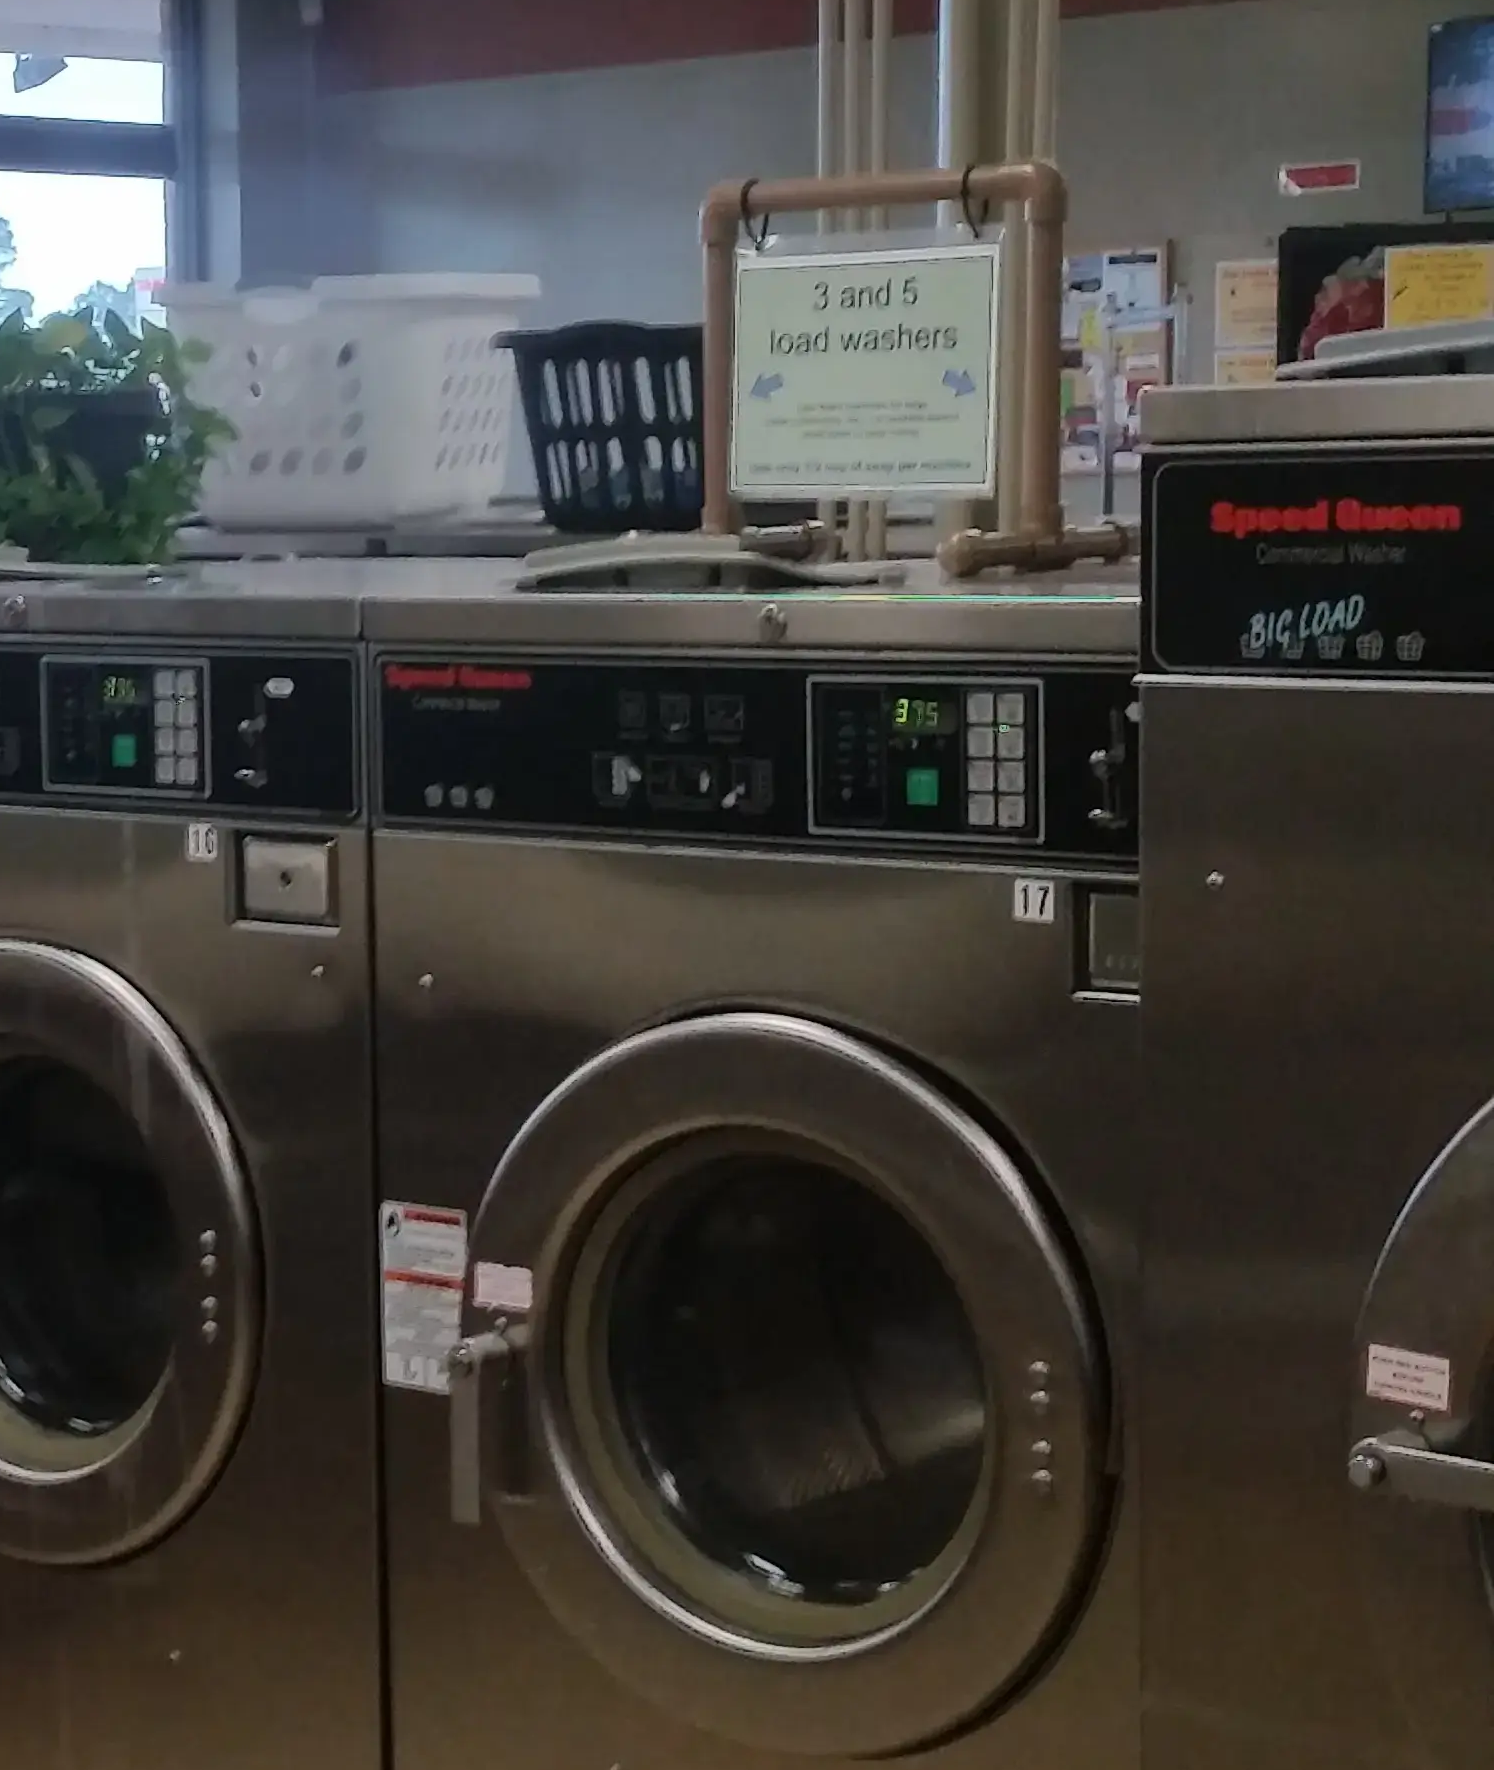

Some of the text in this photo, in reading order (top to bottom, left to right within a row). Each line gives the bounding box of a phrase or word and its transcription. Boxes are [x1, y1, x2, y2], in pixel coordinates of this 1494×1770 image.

[813, 276, 919, 311] 3 and 5
[770, 323, 958, 355] load washers
[1211, 498, 1461, 538] Speed Queen
[1249, 594, 1366, 649] BIG LOAD
[1019, 884, 1051, 918] 17
